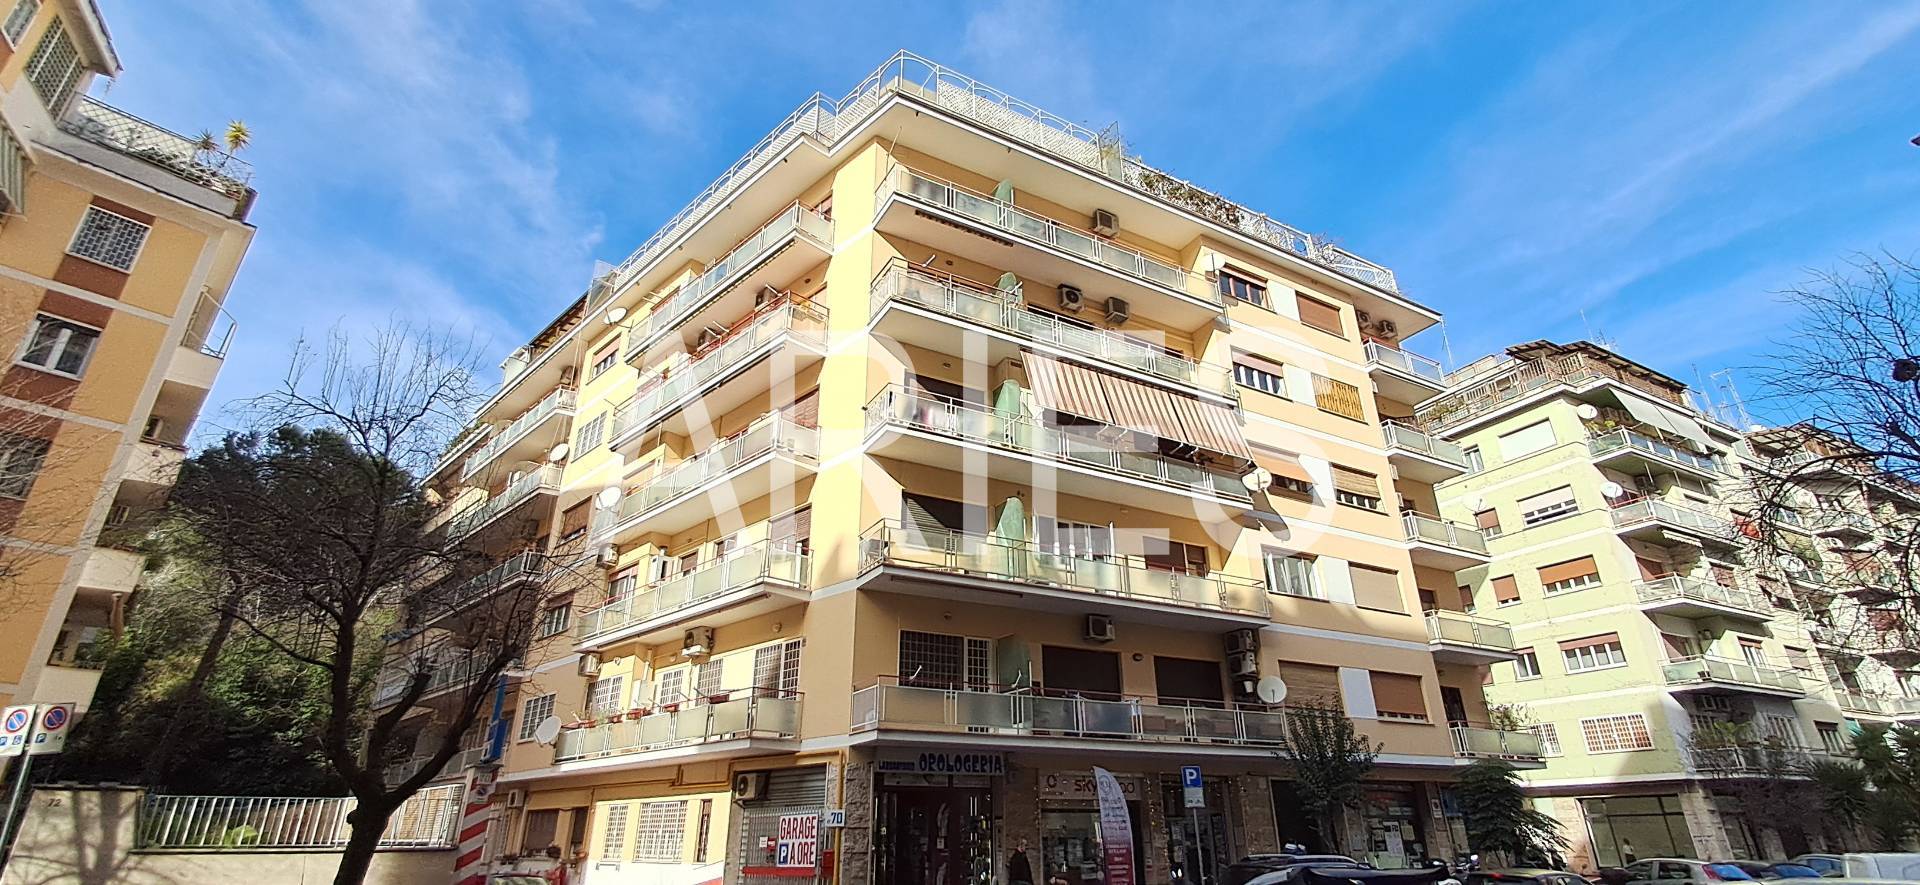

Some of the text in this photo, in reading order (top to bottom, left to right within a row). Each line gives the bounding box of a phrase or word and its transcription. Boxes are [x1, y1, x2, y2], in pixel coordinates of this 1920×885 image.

[919, 753, 1003, 774] OROLOGERIA
[1185, 768, 1197, 785] P
[48, 798, 62, 807] 72
[831, 812, 843, 824] 70
[780, 816, 817, 840] GARAGE
[789, 842, 796, 865] A
[797, 842, 815, 865] ORE
